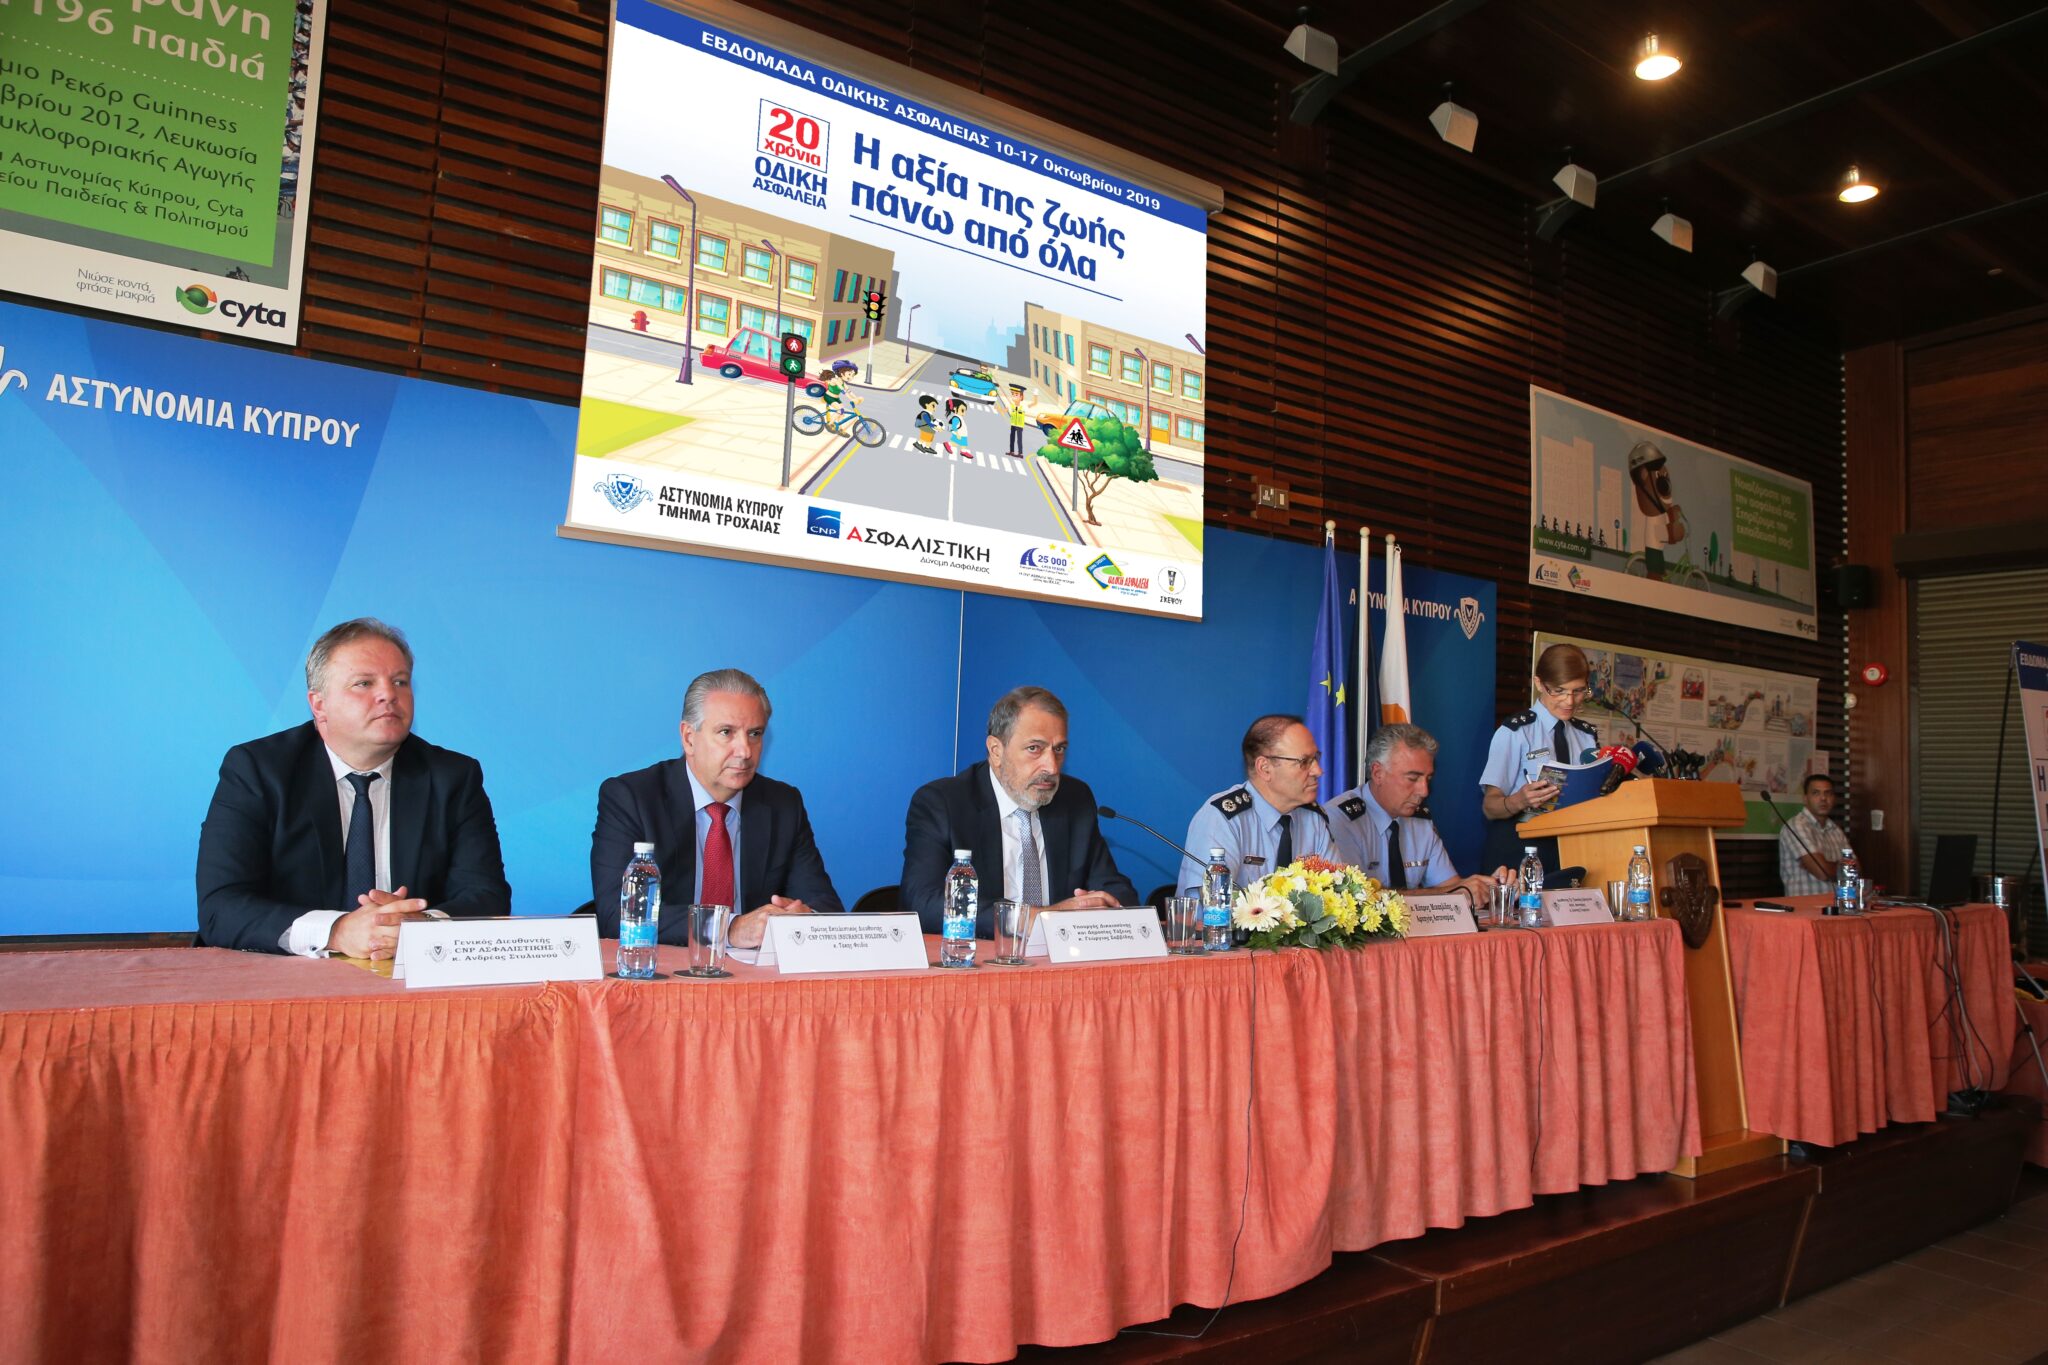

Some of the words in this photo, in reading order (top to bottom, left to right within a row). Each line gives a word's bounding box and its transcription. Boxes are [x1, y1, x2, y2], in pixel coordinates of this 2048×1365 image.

[133, 25, 264, 80] παιδιά
[51, 68, 123, 105] Ρεκόρ
[133, 92, 238, 134] Guinness
[81, 105, 145, 139] 2012,
[154, 126, 257, 164] Λευκωσία
[701, 30, 816, 85] ΕΒΔΟΜΑΔΑ
[822, 76, 888, 111] ΟΔΙΚΗΣ
[894, 102, 989, 148] ΑΣΦΑΛΕΙΑΣ
[996, 141, 1038, 165] 10-17
[1043, 158, 1122, 196] Οκτωβρίου
[1127, 189, 1160, 210] 2019
[768, 107, 820, 150] 20
[763, 138, 821, 167] χρόνια
[10, 152, 122, 192] Αστυνομίας
[129, 179, 200, 210] Κύπρου,
[207, 198, 244, 218] Cyta
[174, 157, 256, 193] Αγωγής
[754, 156, 827, 196] ΟΔΙΚΗ
[46, 180, 128, 214] Παιδείας
[133, 201, 148, 215] &
[155, 205, 249, 238] Πολιτισμού
[752, 177, 827, 210] ΑΣΦΑΛΕΙΑ
[853, 132, 880, 171] Η
[891, 153, 968, 200] αξία
[978, 182, 1034, 229] της
[1042, 198, 1126, 259] ζωής
[851, 181, 954, 235] πάνω
[964, 217, 1029, 259] από
[1038, 237, 1097, 282] όλα
[76, 281, 113, 296] φτάσε
[116, 288, 156, 304] μακριά
[77, 268, 115, 286] Νιώσε
[219, 299, 286, 328] cyta
[45, 373, 235, 431] ΑΣΤΥΝΟΜΙΑ
[243, 405, 361, 449] ΚΥΠΡΟΥ
[657, 503, 711, 523] ΤΜΗΜΑ
[715, 513, 781, 535] ΤΡΟΧΑΙΑΣ
[659, 485, 733, 512] ΑΣΤΥΝΟΜΙΑ
[736, 498, 784, 520] ΚΥΠΡΟΥ
[810, 525, 837, 536] CNP
[846, 526, 990, 563] ΑΣΦΑΛΙΣΤΙΚΗ
[1538, 536, 1587, 555] www.cyta.com.cy
[1038, 554, 1049, 564] 25
[1412, 599, 1452, 621] ΚΥΠΡΟΥ
[453, 938, 493, 946] Γενικός
[496, 937, 551, 945] Διευθυντής
[464, 954, 506, 962] Ανδρέας
[509, 952, 558, 960] Στυλιανού
[478, 944, 554, 953] ΑΣΦΑΛΙΣΤΙΚΗΣ
